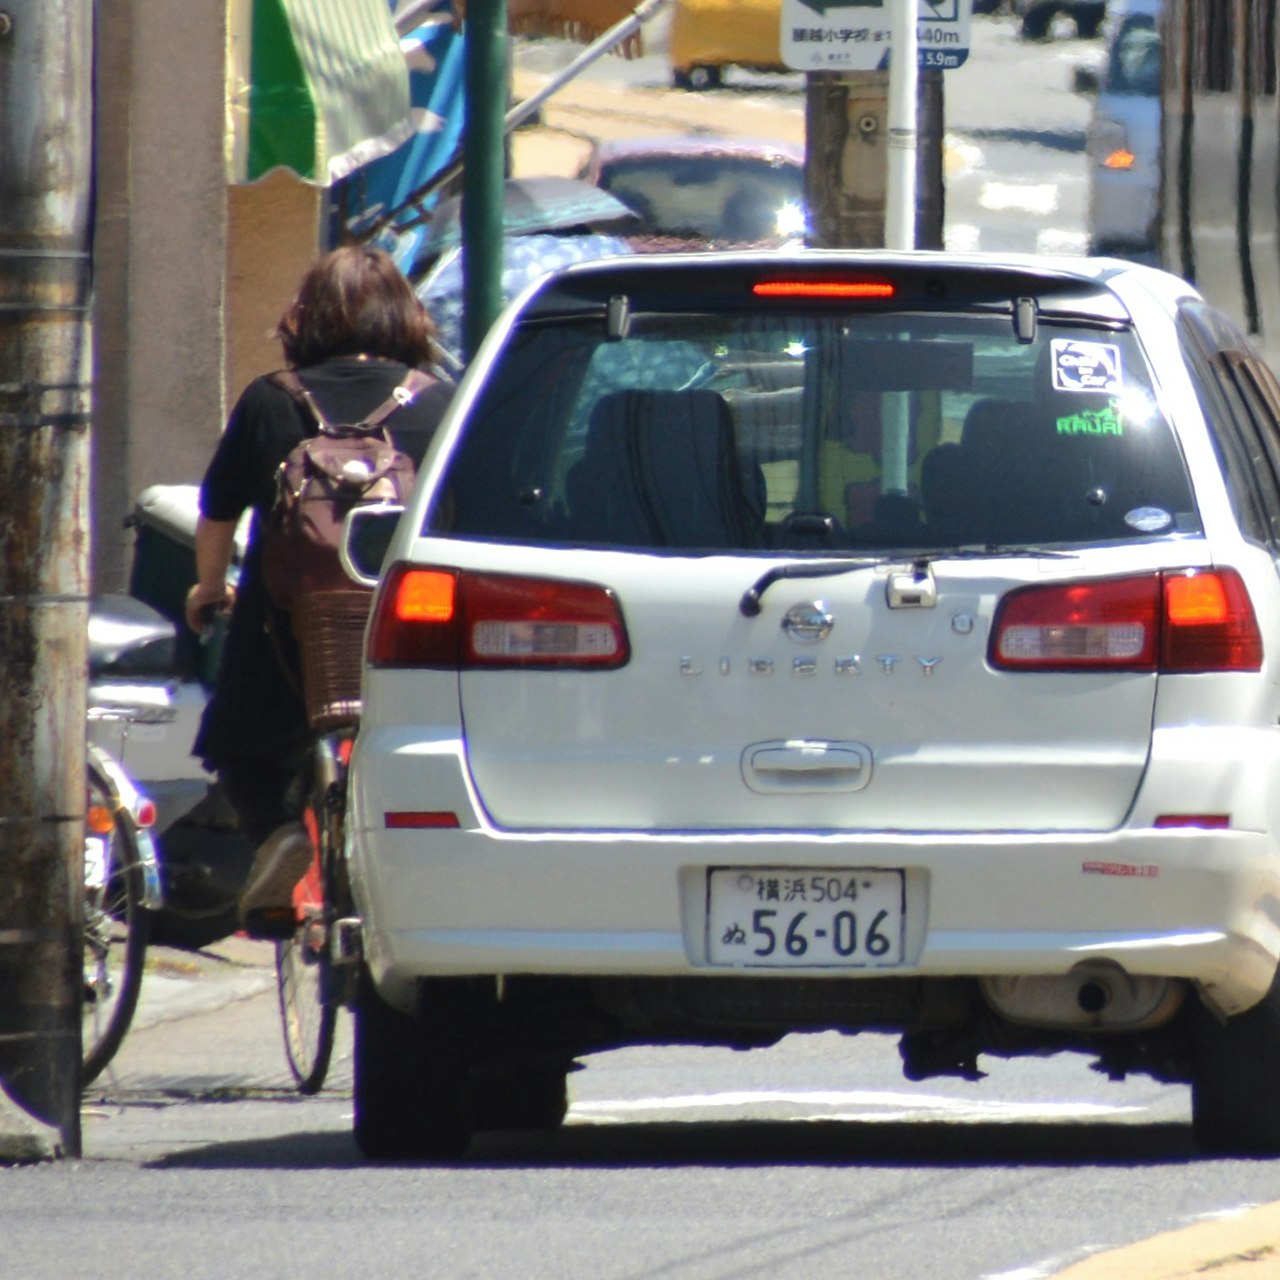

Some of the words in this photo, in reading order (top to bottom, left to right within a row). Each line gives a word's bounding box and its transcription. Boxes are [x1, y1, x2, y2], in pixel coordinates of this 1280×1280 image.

[680, 655, 943, 676] LIBERTY
[721, 923, 747, 946] ぬ
[752, 909, 891, 957] 56-06
